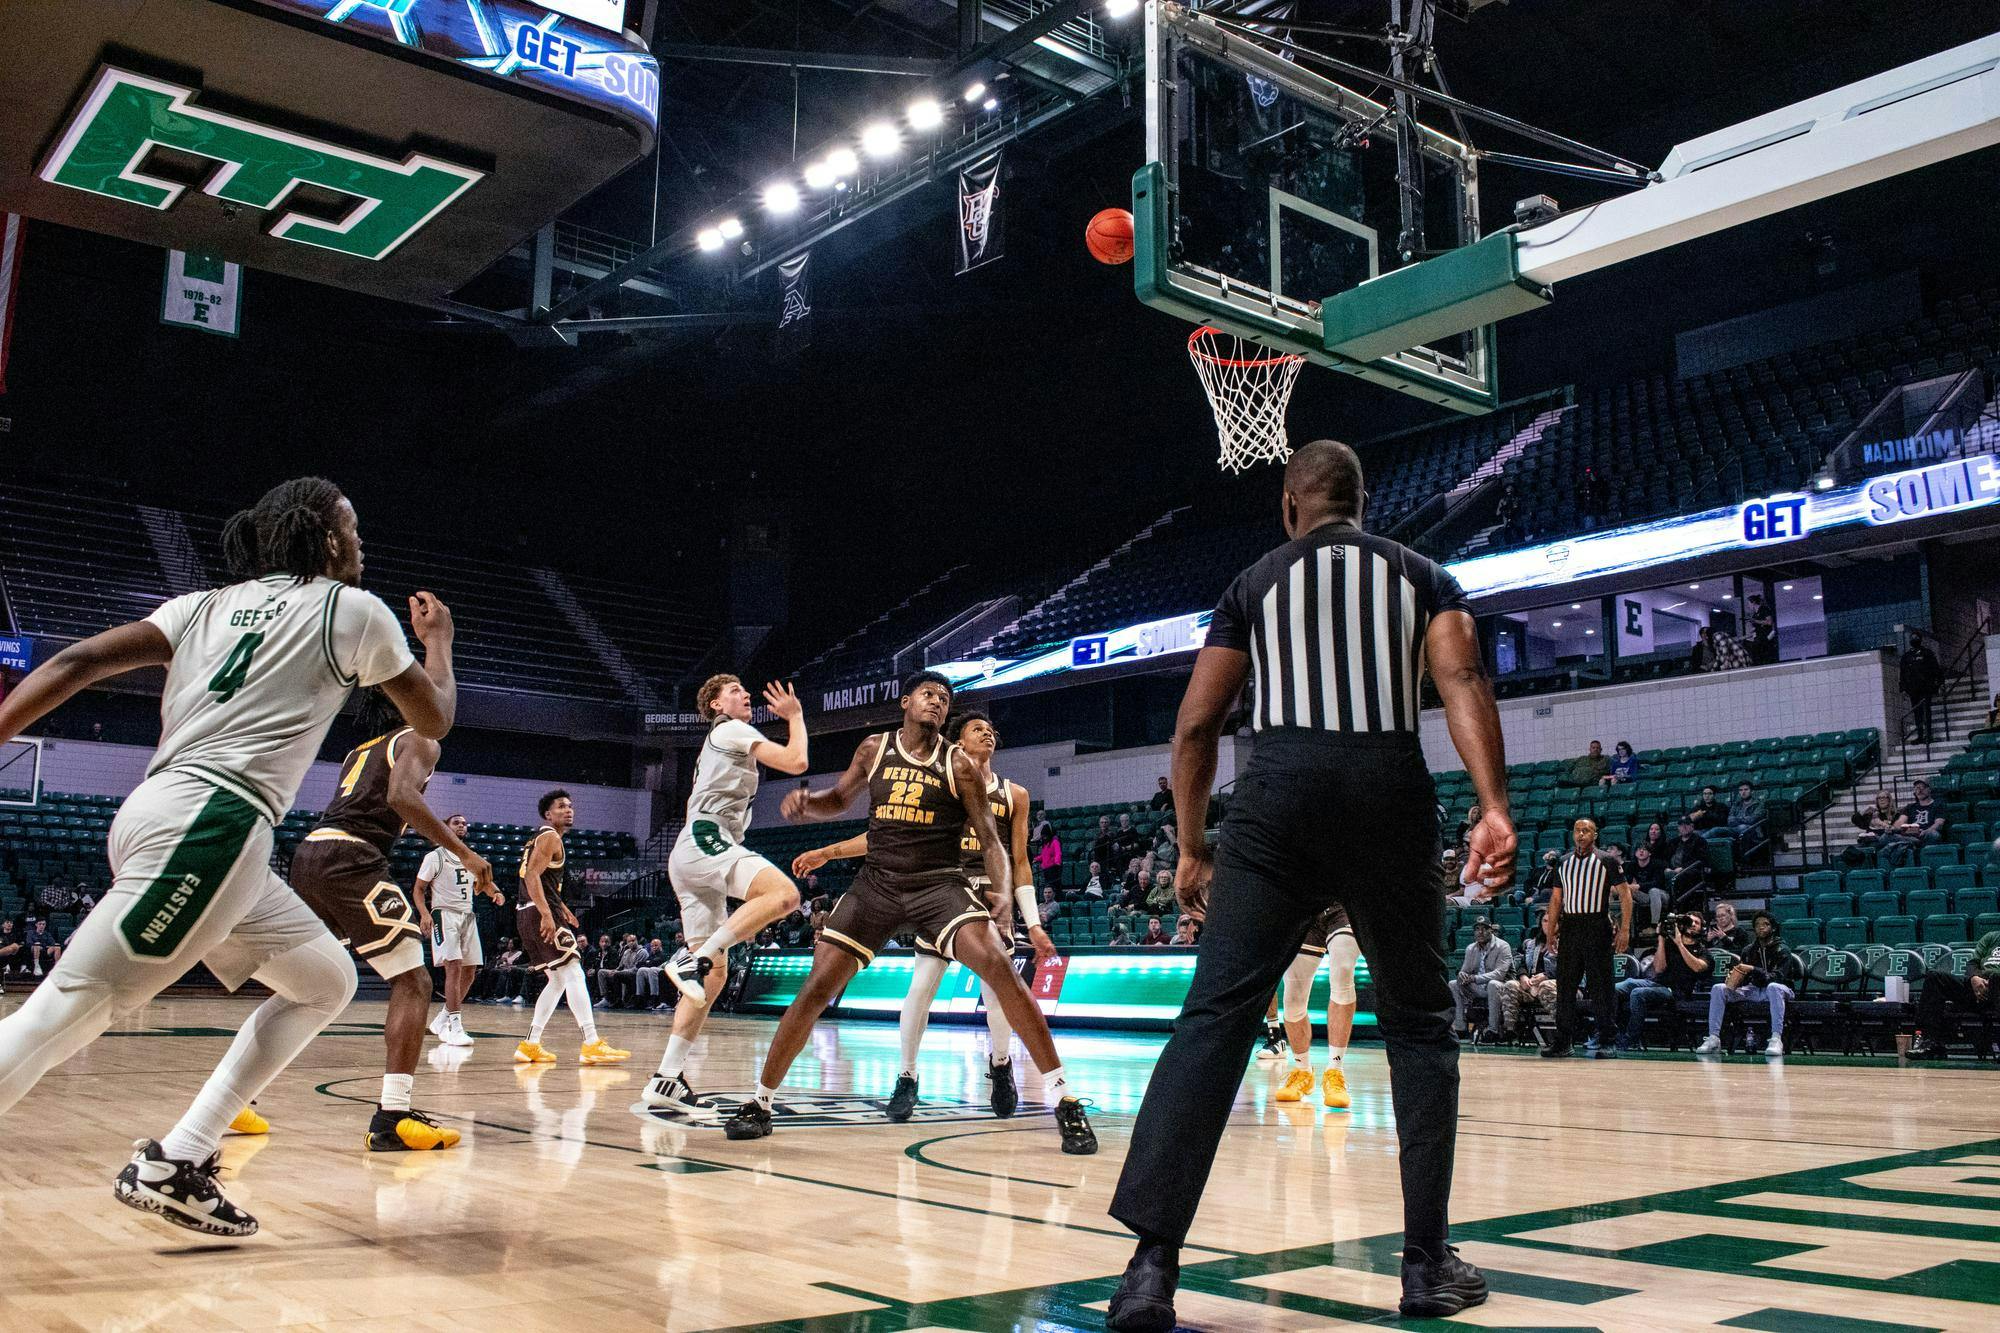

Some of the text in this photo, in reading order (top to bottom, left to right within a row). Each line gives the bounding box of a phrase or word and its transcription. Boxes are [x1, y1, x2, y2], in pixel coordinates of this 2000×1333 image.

[516, 25, 582, 78] GET
[193, 302, 210, 323] E
[1743, 454, 1994, 541] GET SOME
[1624, 599, 1643, 637] E
[1138, 616, 1198, 657] SOME
[2, 657, 26, 668] DTE
[208, 630, 265, 704] 4
[823, 679, 900, 712] MARLATT '70
[645, 714, 677, 724] GEORGE
[340, 749, 371, 798] 4
[888, 782, 924, 807] 22
[875, 805, 935, 825] MICHIGAN
[455, 868, 468, 885] E
[461, 888, 467, 900] 5
[140, 873, 202, 944] EASTERN
[1711, 954, 1732, 977] E
[1825, 955, 1847, 977] E
[1887, 953, 1909, 976] E
[1042, 974, 1053, 993] 3
